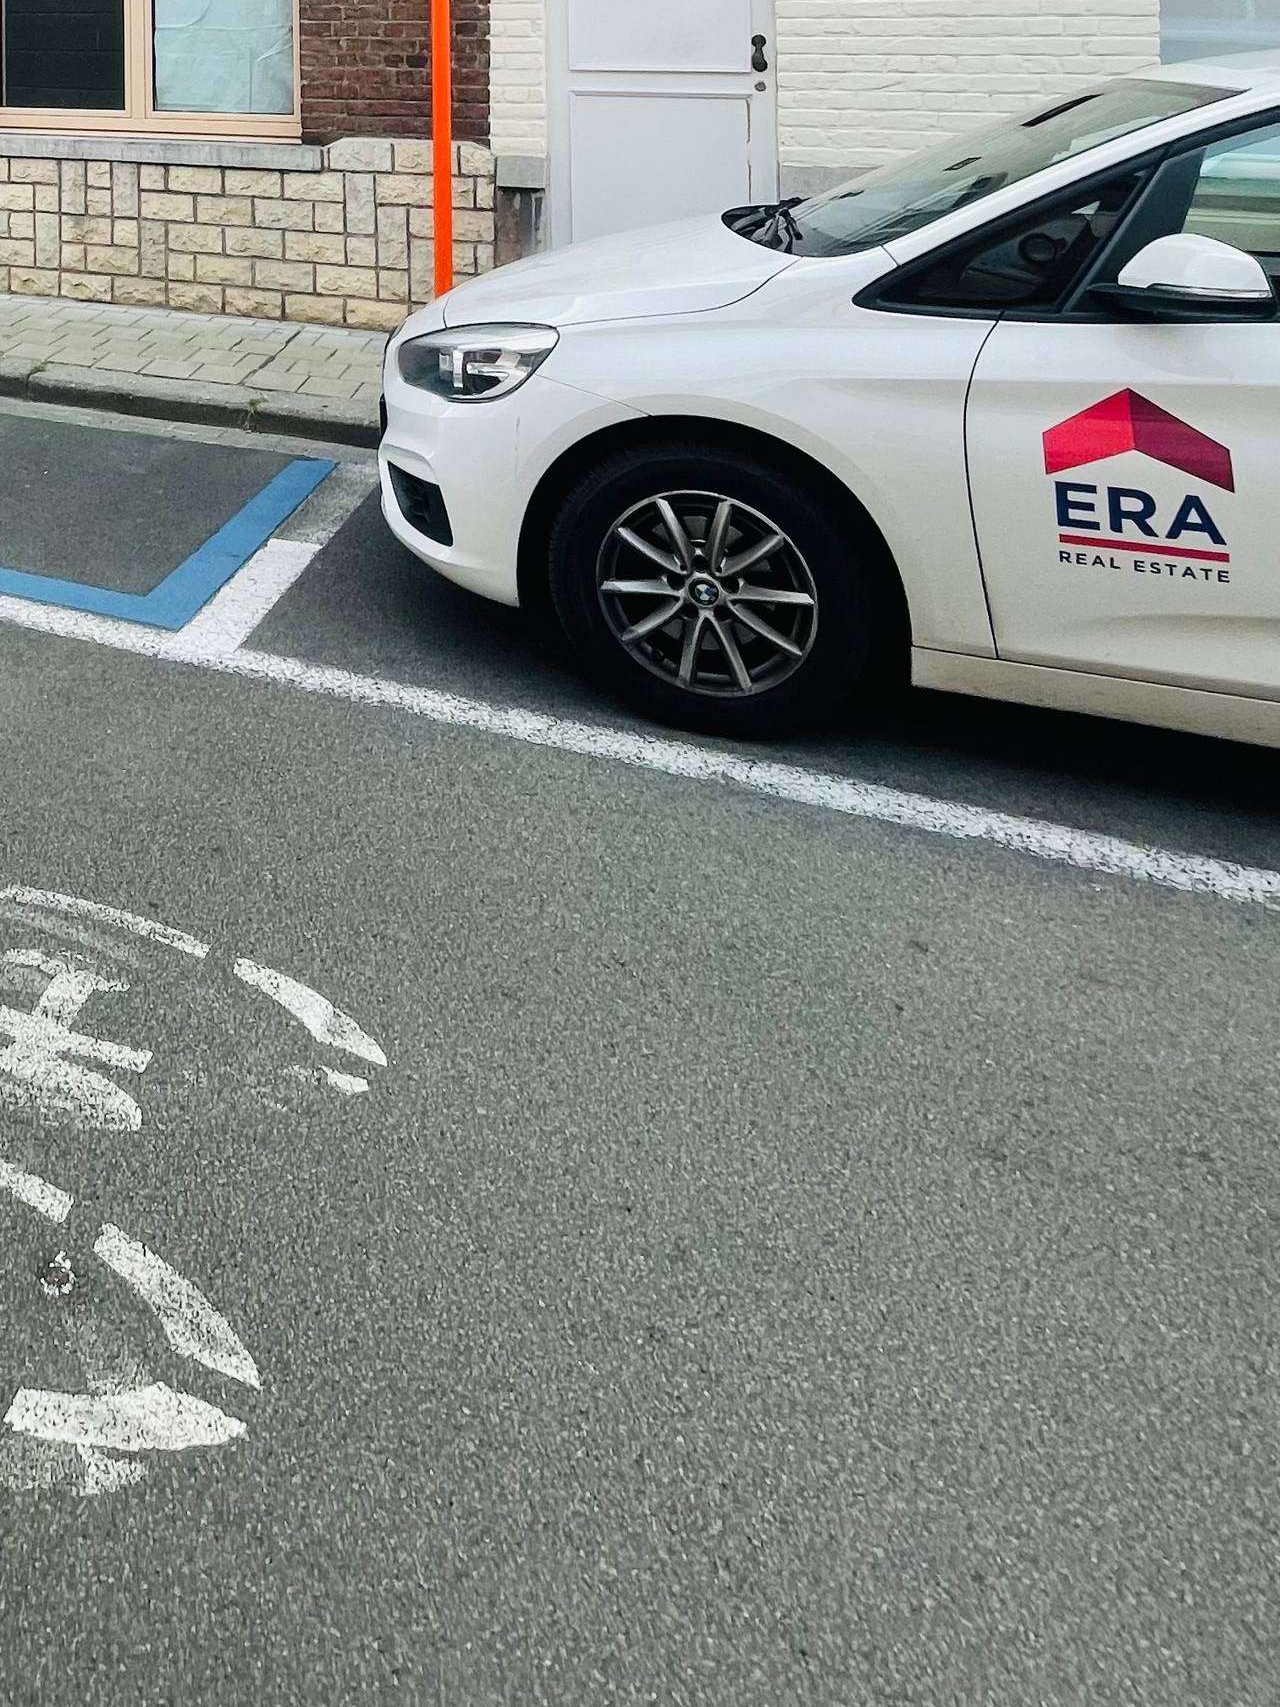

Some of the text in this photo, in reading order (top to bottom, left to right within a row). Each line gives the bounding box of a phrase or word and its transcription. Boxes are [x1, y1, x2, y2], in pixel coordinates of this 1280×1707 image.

[1054, 480, 1227, 546] ERA
[1059, 550, 1231, 583] REAL ESTATE
